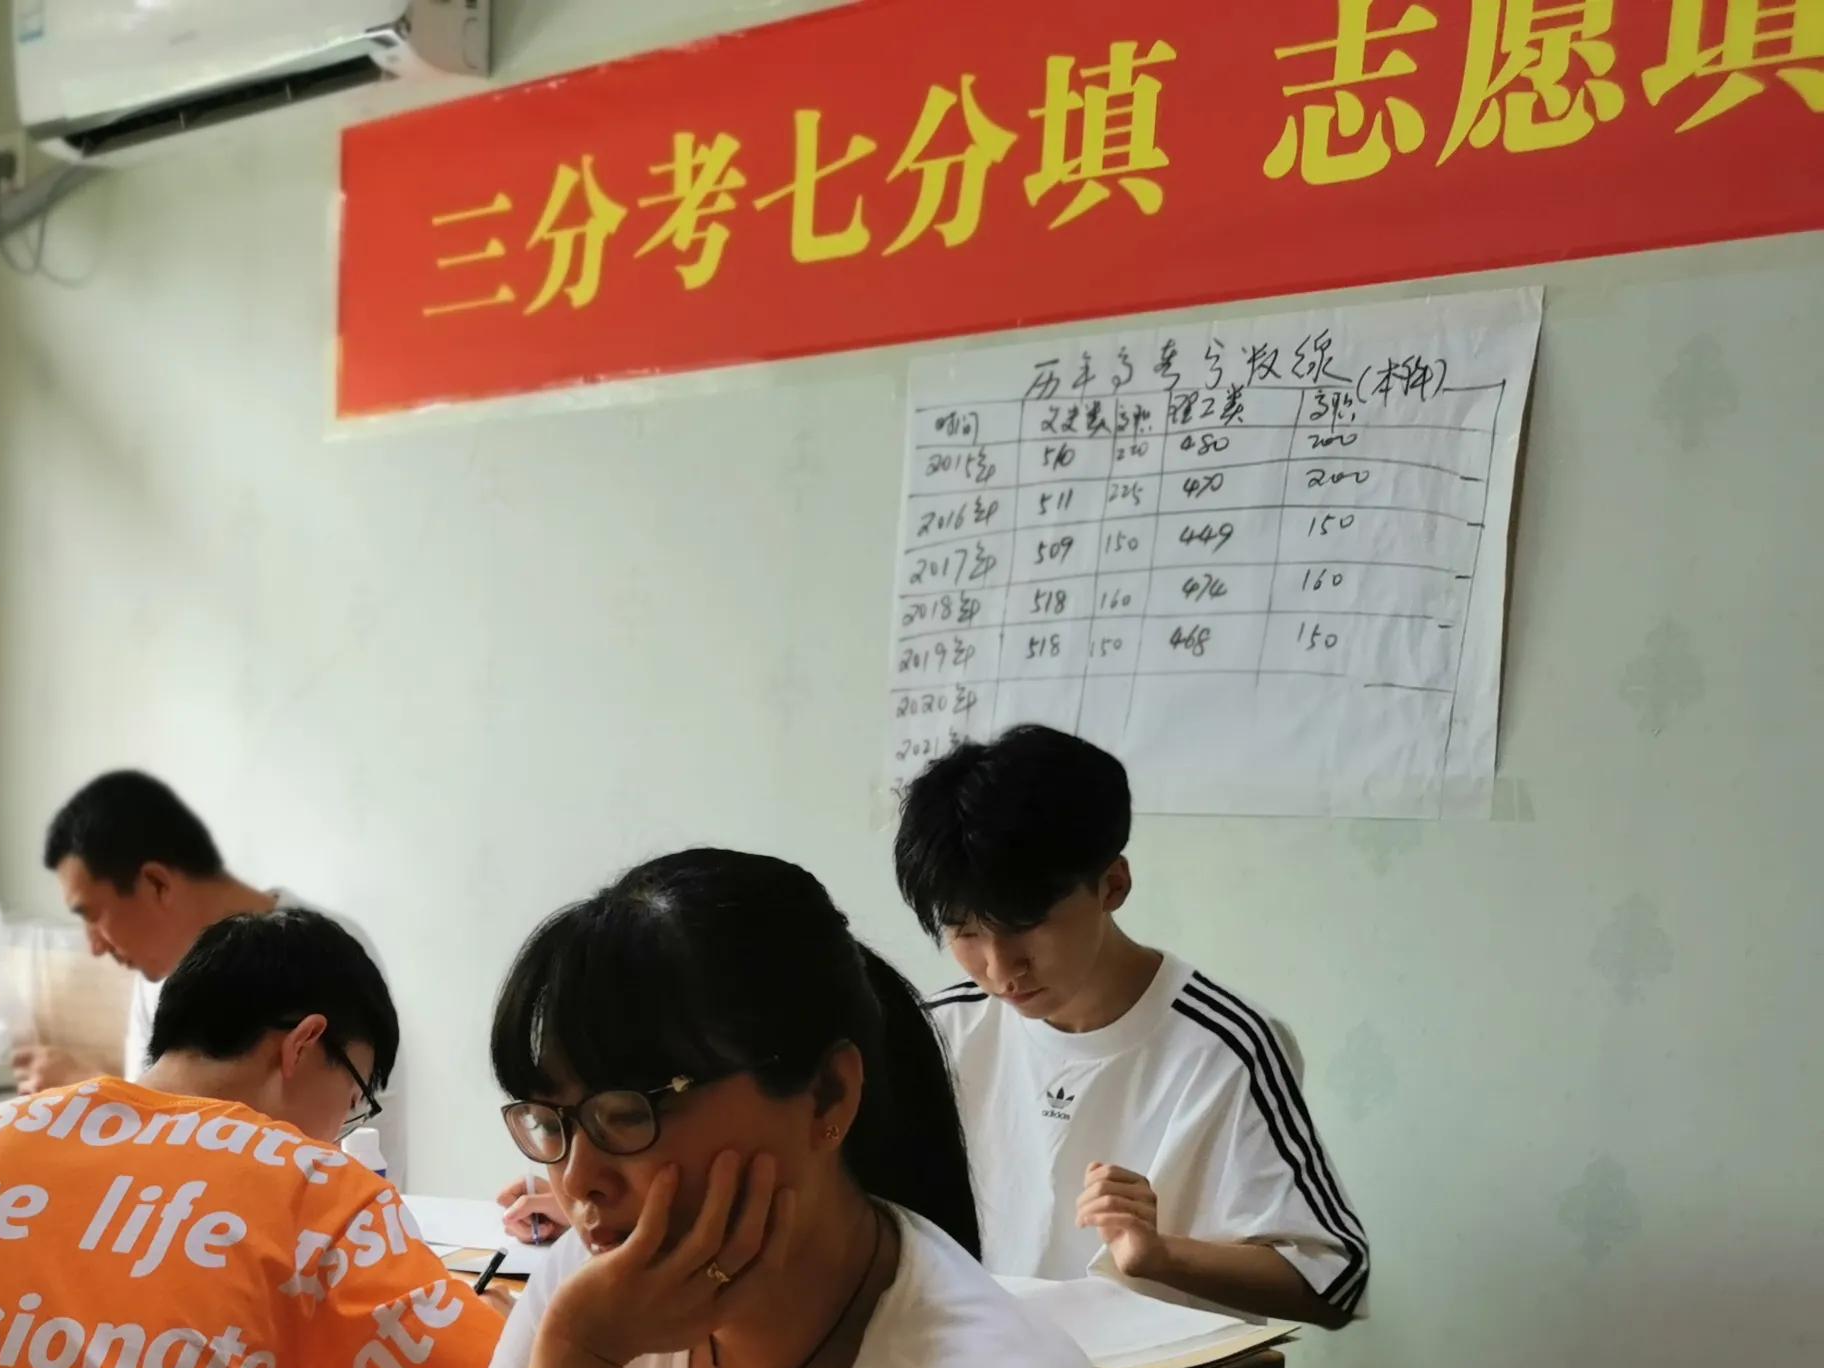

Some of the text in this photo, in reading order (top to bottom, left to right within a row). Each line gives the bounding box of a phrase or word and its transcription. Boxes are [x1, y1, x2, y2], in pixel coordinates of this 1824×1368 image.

[423, 39, 1176, 315] 三分考七分填
[926, 445, 997, 484] 2015年
[1180, 434, 1230, 456] 480
[917, 495, 999, 538] 2016年
[1038, 488, 1074, 516] 511
[910, 513, 1355, 588] 2017年 509 150 449 150
[902, 589, 981, 627] 2018年
[1030, 588, 1068, 616] 518
[1100, 588, 1132, 611] 160
[1302, 567, 1344, 592] 160
[898, 635, 976, 674] 2019年
[1025, 633, 1062, 660] 518
[1089, 637, 1123, 658] 150
[1297, 620, 1339, 651] 150
[895, 682, 977, 719] 2020年
[79, 1174, 248, 1278] life
